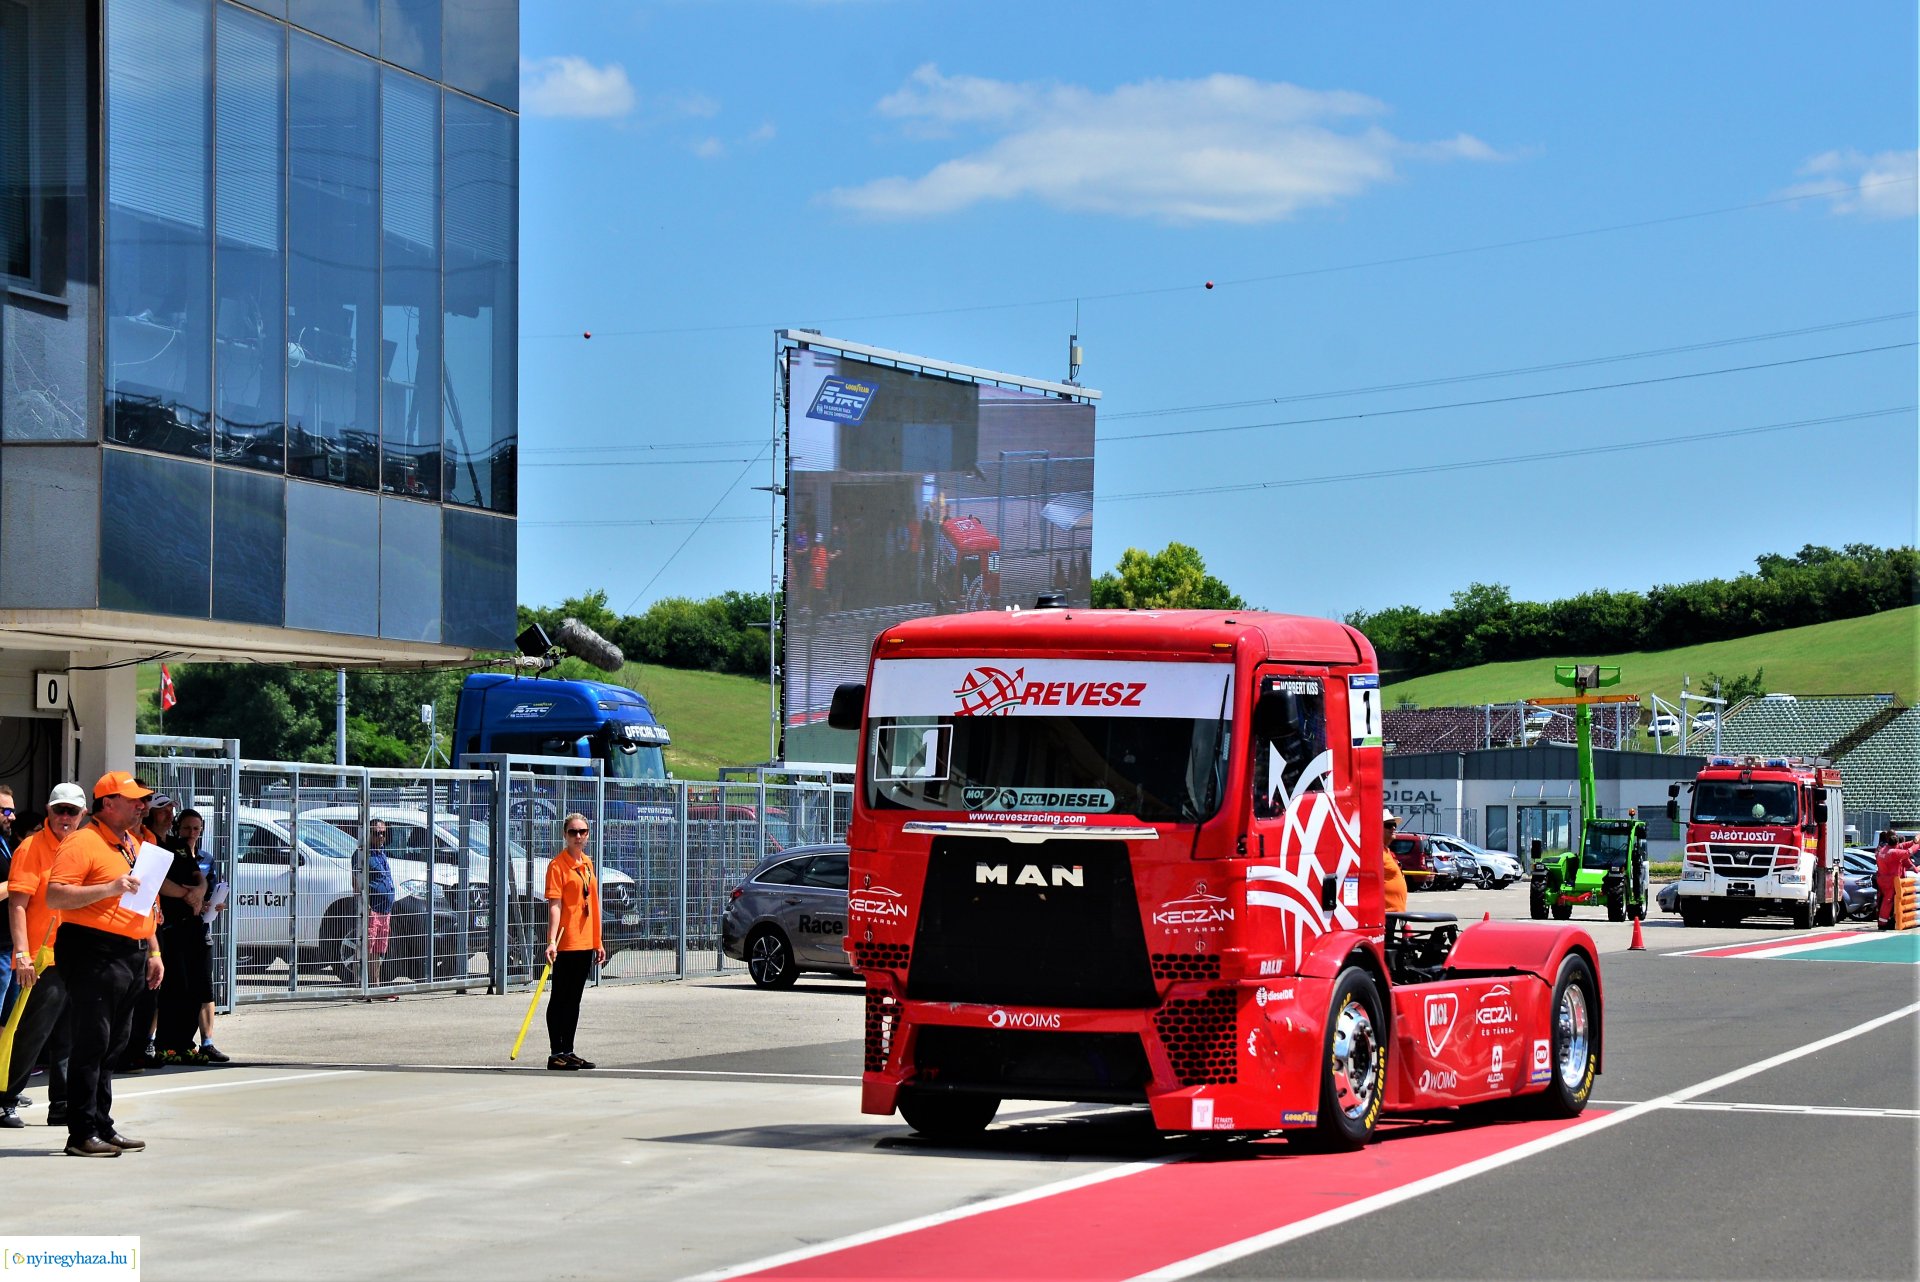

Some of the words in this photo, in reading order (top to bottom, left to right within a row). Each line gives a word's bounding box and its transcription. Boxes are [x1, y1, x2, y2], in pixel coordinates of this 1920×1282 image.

[1020, 682, 1147, 707] REVESZ
[1306, 682, 1319, 695] KISS
[1363, 690, 1372, 735] 1
[624, 725, 655, 738] OFFICIAL
[922, 729, 939, 777] 1
[965, 789, 985, 799] MOL
[969, 812, 1087, 825] www.reveszracing.com
[976, 862, 1084, 887] MAN
[264, 890, 288, 907] Car
[799, 915, 843, 934] Race
[868, 916, 897, 926] TÁRSA
[1186, 926, 1224, 934] TÁRSA
[1260, 959, 1283, 975] BALU
[1009, 1013, 1061, 1028] WOIMS
[1429, 1003, 1448, 1026] MOL
[1364, 1046, 1385, 1130] GOODYEAR
[1430, 1070, 1457, 1089] WOIMS
